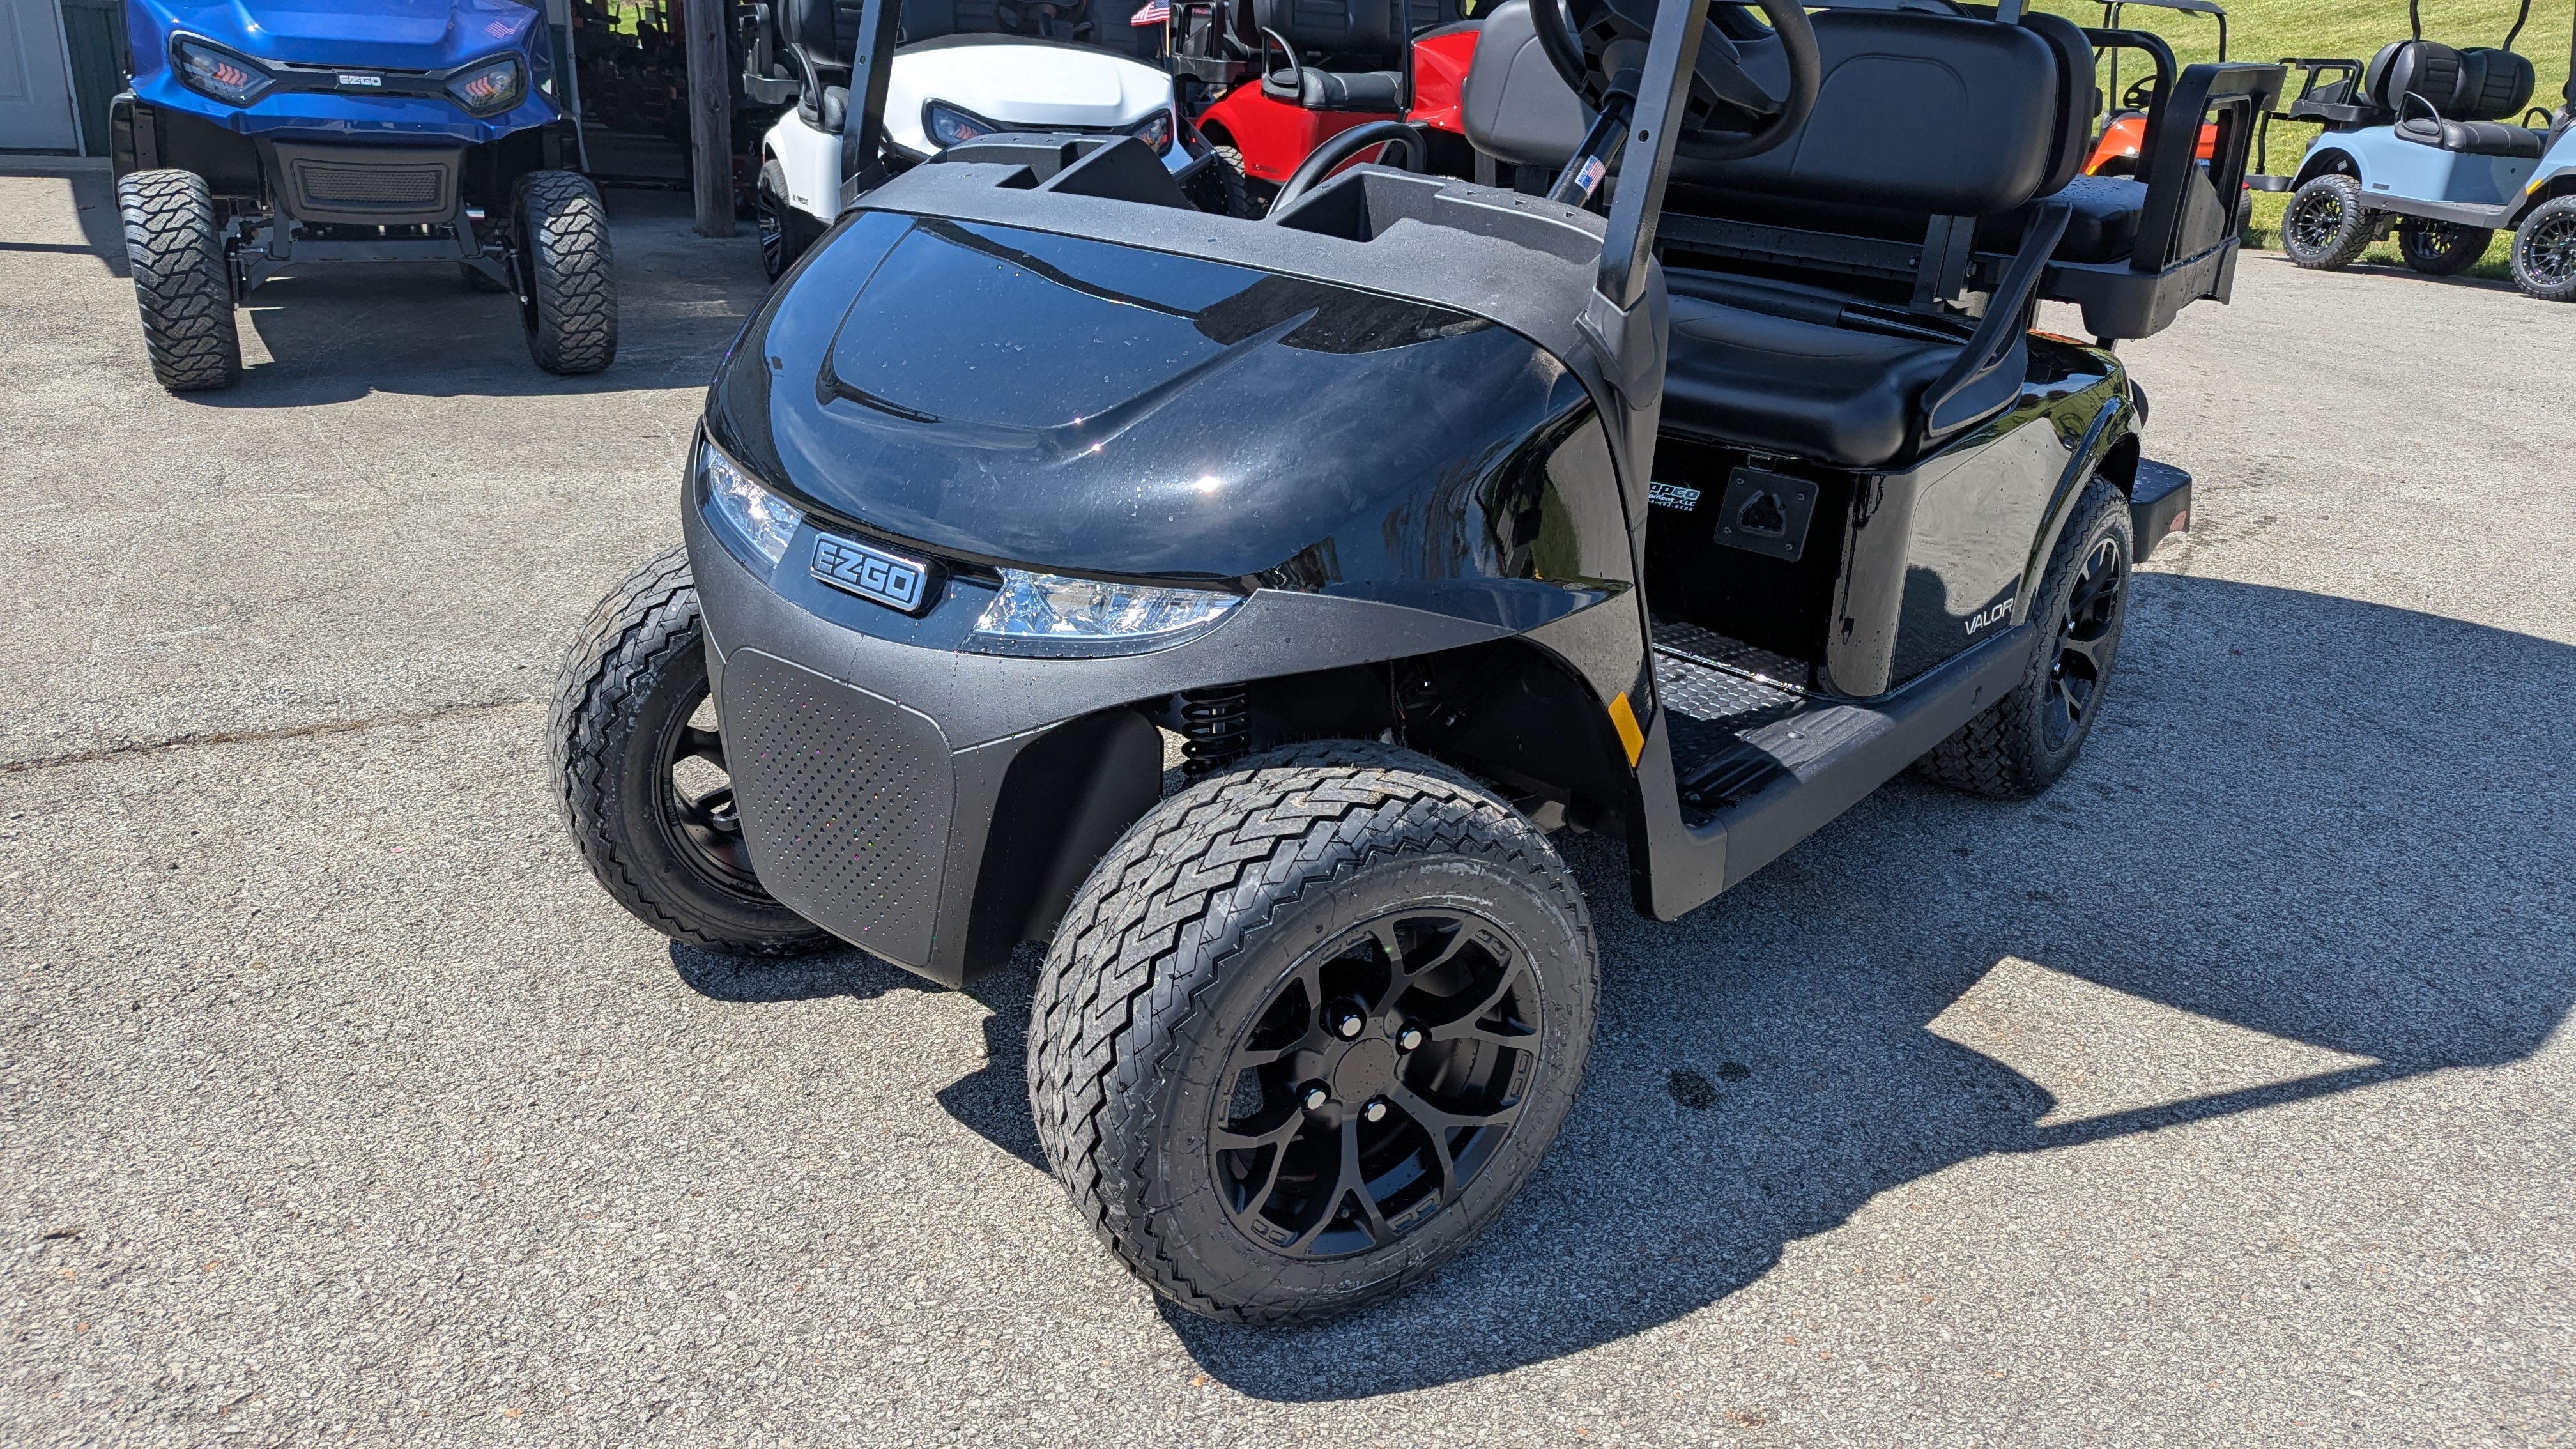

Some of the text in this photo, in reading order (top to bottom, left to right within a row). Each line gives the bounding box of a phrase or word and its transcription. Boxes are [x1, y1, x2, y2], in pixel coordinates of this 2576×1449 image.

[339, 75, 381, 86] EZGO
[1577, 170, 1587, 183] BUILT
[1650, 481, 1701, 501] PPCO
[814, 541, 916, 602] EZGO
[1964, 597, 2014, 636] VALOR
